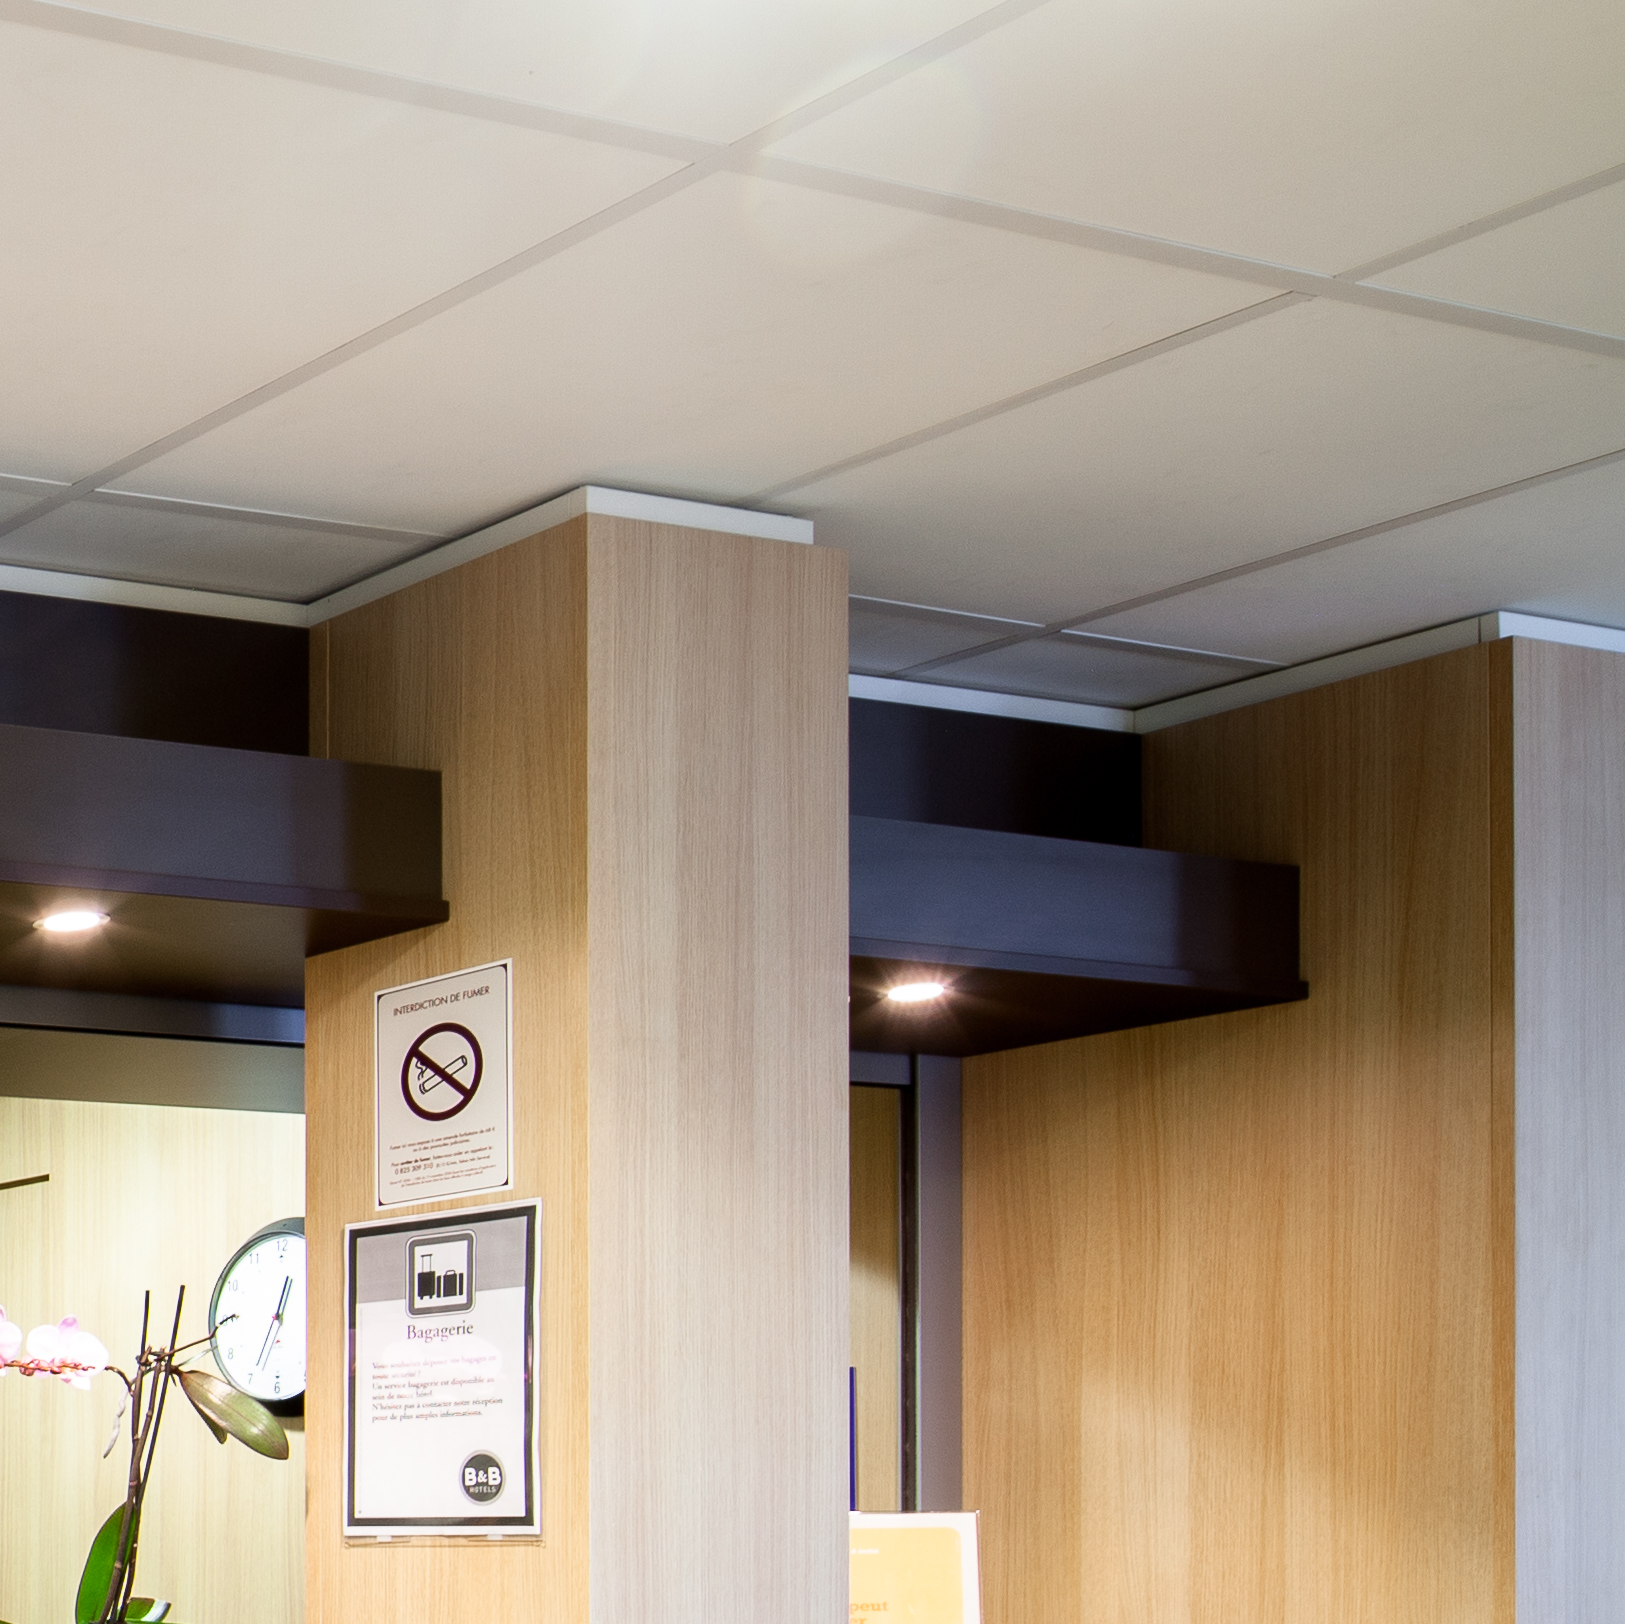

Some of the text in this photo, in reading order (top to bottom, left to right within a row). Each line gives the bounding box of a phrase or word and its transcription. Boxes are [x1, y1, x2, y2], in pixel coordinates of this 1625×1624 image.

[393, 986, 490, 1017] INTERDICTION DE FUMER
[276, 1240, 288, 1252] 12
[249, 1254, 259, 1264] 11
[228, 1280, 238, 1292] 10
[407, 1319, 474, 1343] Bagagerie
[227, 1348, 234, 1360] 8
[462, 1354, 487, 1365] bagages
[247, 1374, 253, 1385] 7
[384, 1381, 406, 1389] service
[408, 1378, 438, 1389] bagagerie
[451, 1375, 484, 1387] disponible
[274, 1382, 280, 1394] 6
[404, 1402, 415, 1412] pas
[422, 1400, 452, 1408] contacter
[472, 1397, 503, 1407] réception
[372, 1415, 388, 1423] pour
[400, 1412, 413, 1422] plus
[464, 1466, 501, 1486] B&B
[469, 1485, 497, 1494] HOTELS
